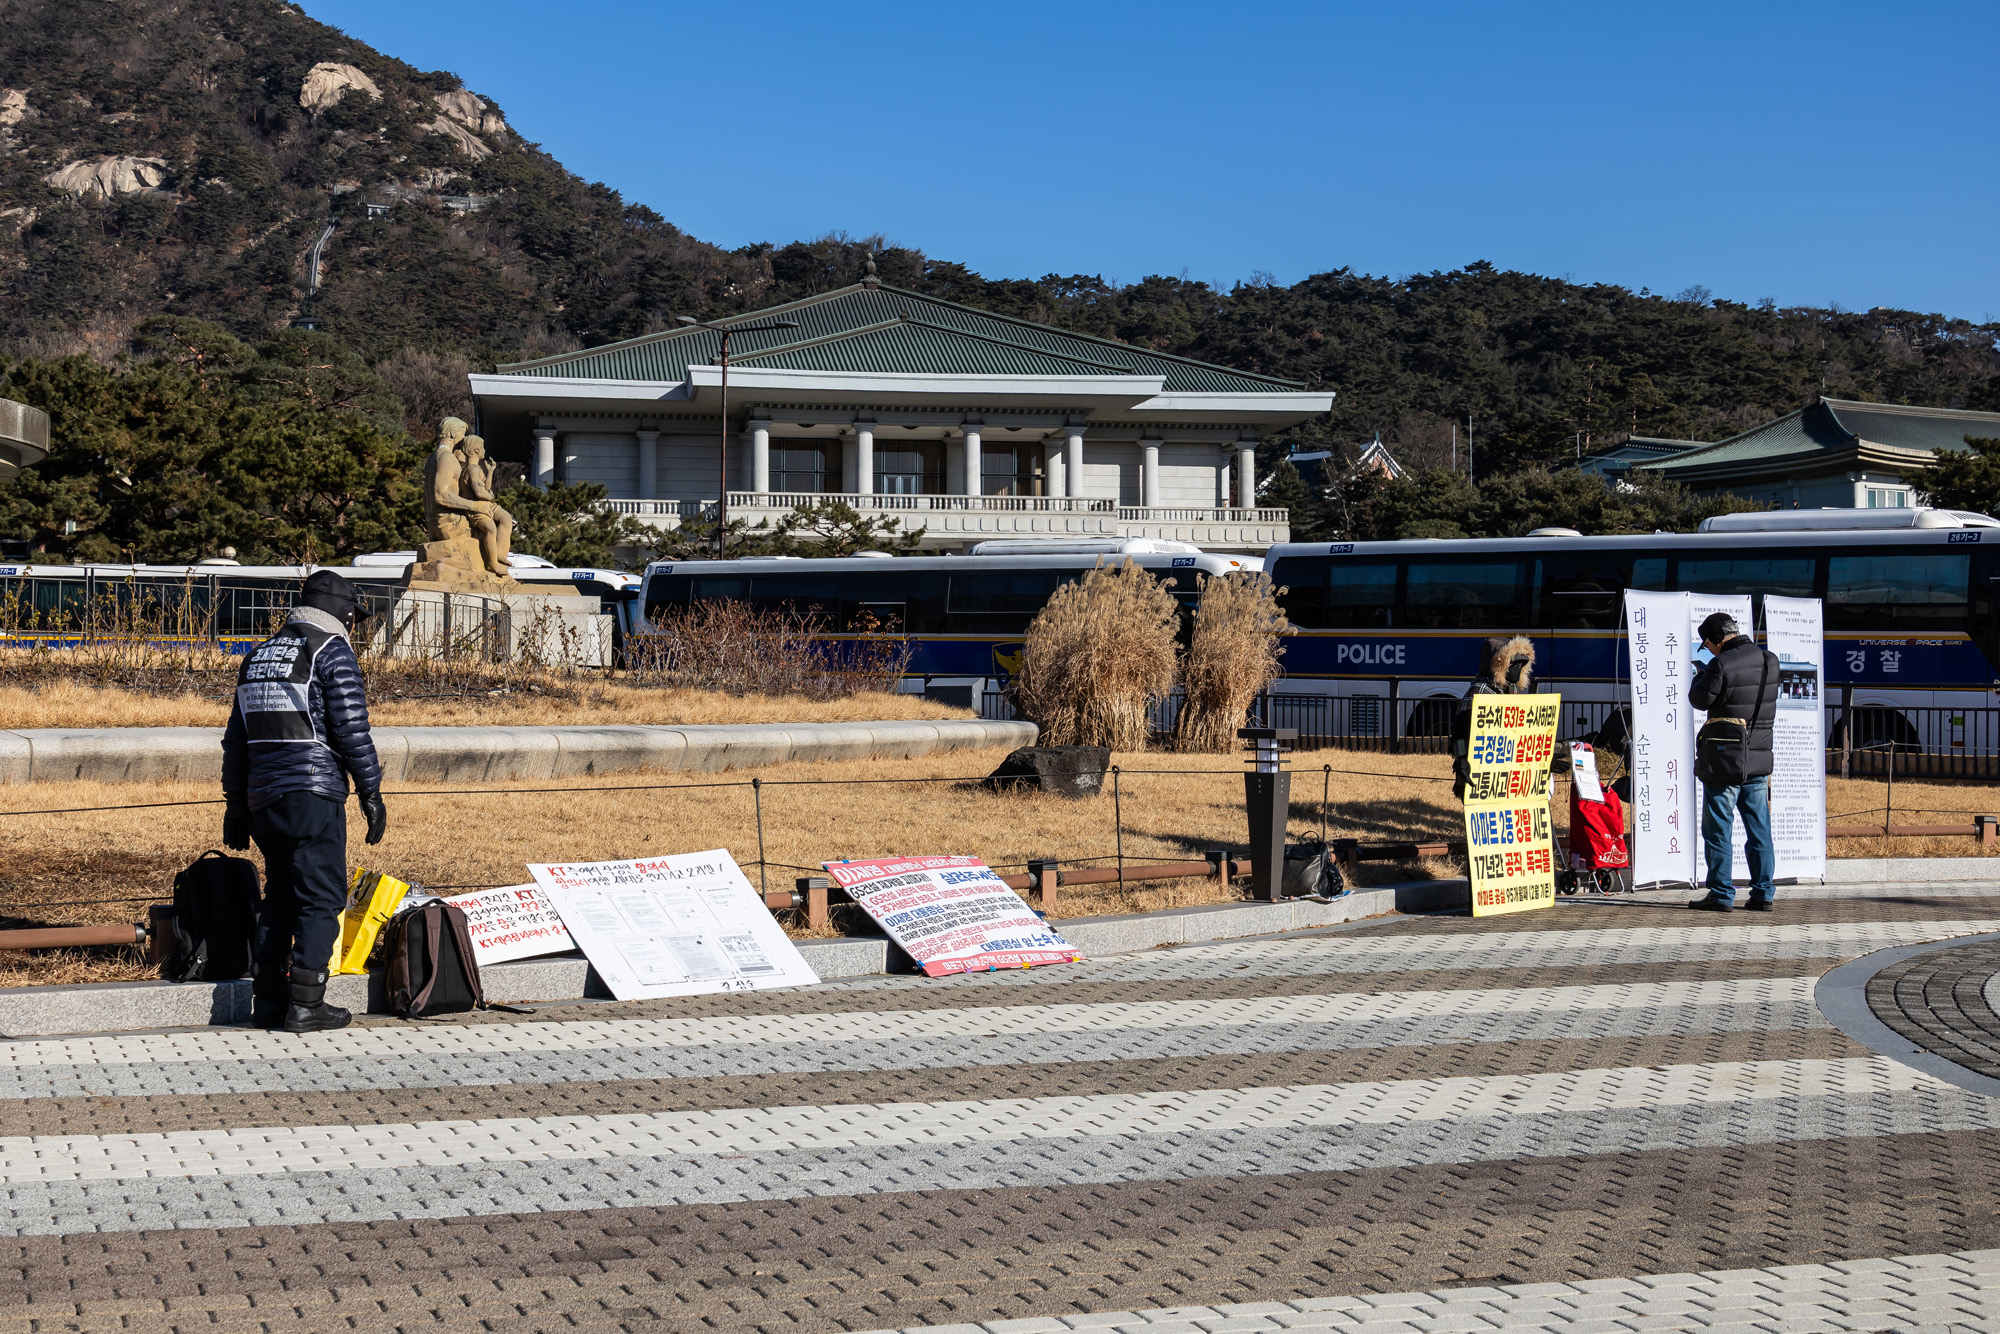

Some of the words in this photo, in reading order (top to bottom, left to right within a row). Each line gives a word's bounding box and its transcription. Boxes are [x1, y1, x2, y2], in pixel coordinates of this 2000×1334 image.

[1950, 533, 1978, 542] 26기-3
[251, 646, 300, 662] 강제단속
[1337, 644, 1406, 664] POLICE
[1633, 606, 1650, 706] 대통령님
[246, 662, 294, 680] 중단하라
[1664, 632, 1679, 731] 추모관이
[1476, 706, 1503, 729] 공수처
[1504, 706, 1525, 728] 531호
[1473, 735, 1515, 765] 국정원의
[1515, 734, 1552, 763] 살인청부
[1530, 768, 1548, 796] 시도
[1636, 733, 1652, 833] 순국선열
[1666, 758, 1681, 855] 위기예요
[1470, 811, 1500, 847] 아파트
[1500, 809, 1514, 845] 2동
[1514, 808, 1532, 844] 강탈
[1533, 807, 1548, 841] 시도
[833, 864, 886, 884] 이재명
[883, 860, 924, 874] 대통령님
[1474, 854, 1504, 881] 17년간
[1504, 852, 1526, 877] 공작,
[1526, 848, 1551, 875] 독극물
[850, 884, 880, 899] GS건설
[870, 891, 898, 906] GS건설
[1477, 889, 1494, 907] 아파트
[1494, 888, 1506, 905] 공실
[872, 909, 884, 918] 2.
[881, 898, 920, 914] 주거생존권
[885, 912, 914, 927] 이재명
[910, 904, 946, 919] 대통령님
[980, 938, 1024, 952] 대통령실
[1031, 934, 1054, 946] 노숙
